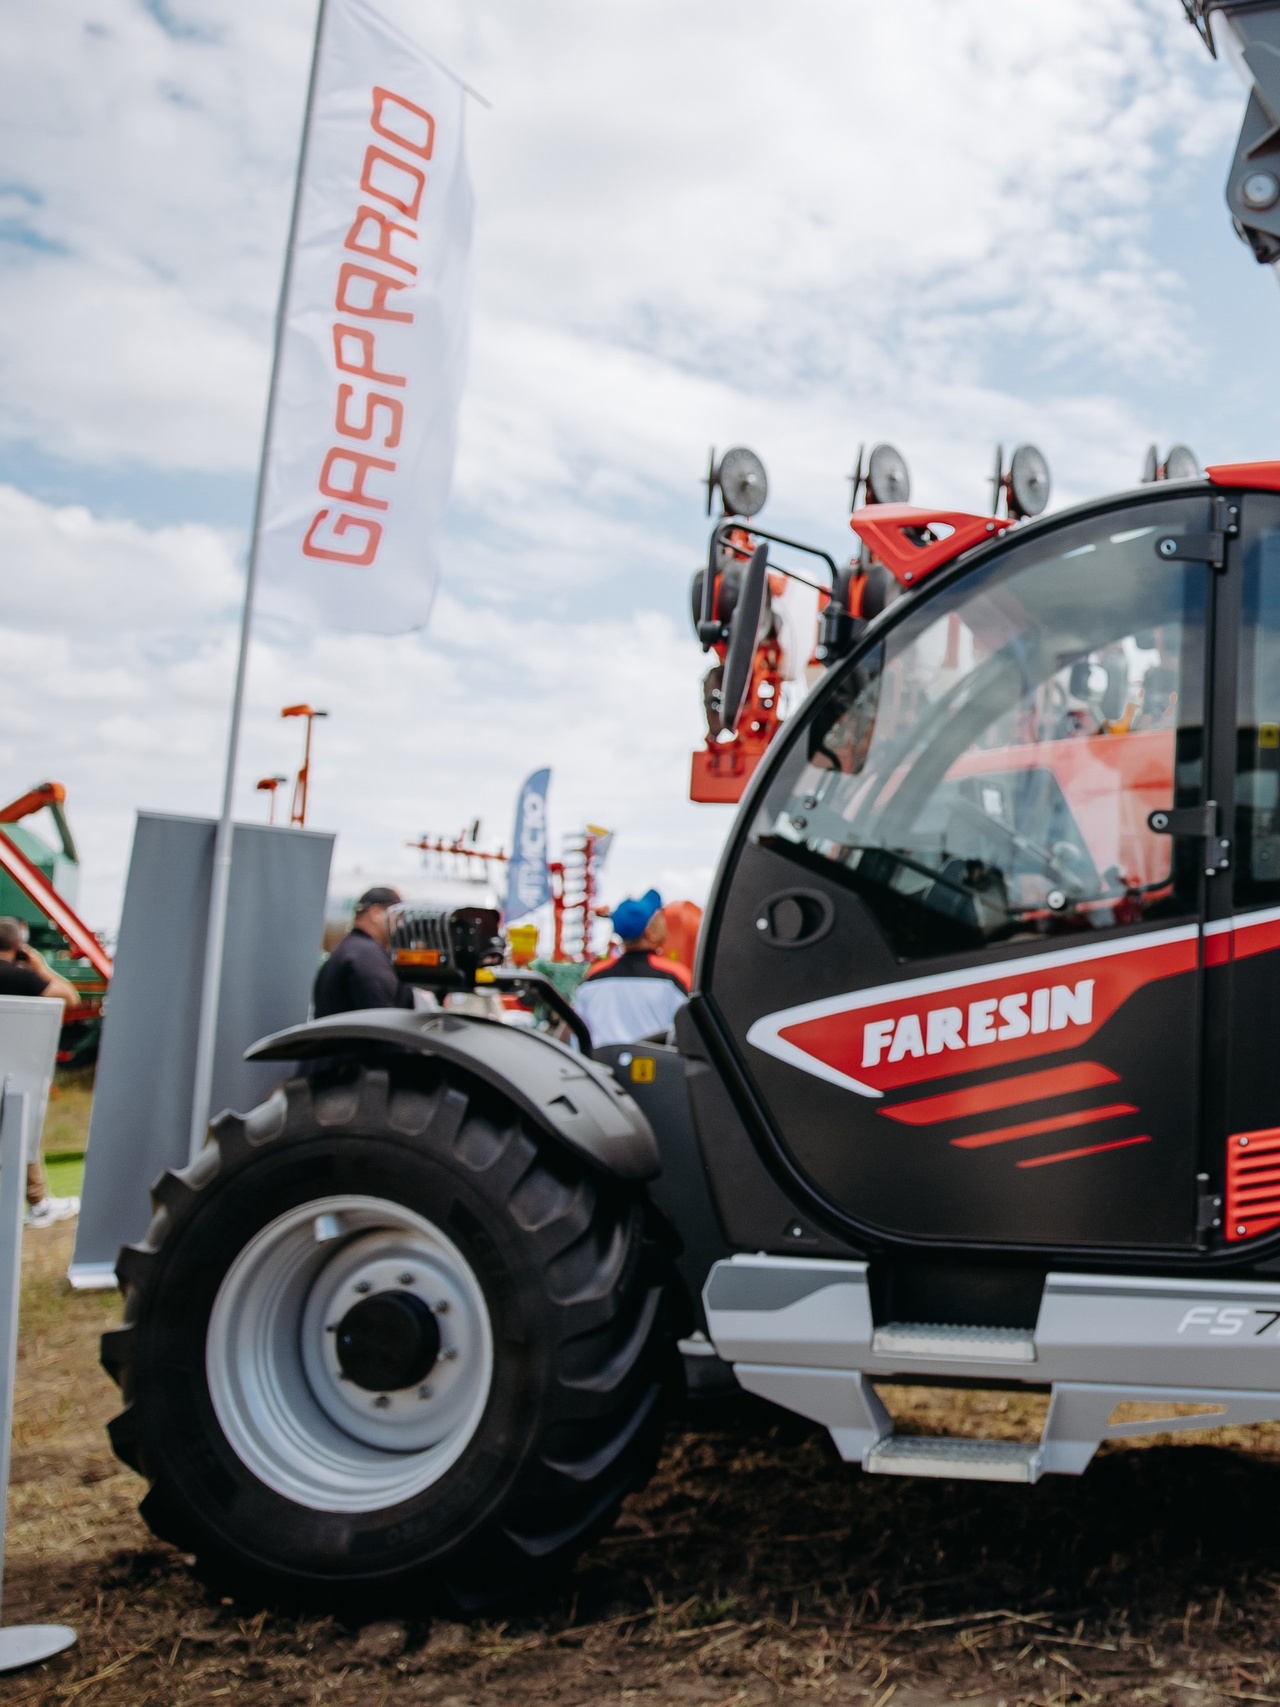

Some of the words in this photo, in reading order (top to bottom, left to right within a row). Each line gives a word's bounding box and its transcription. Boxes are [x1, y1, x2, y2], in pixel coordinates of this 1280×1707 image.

[302, 85, 435, 566] GASPARDO
[861, 979, 1095, 1068] FARESIN
[1177, 1306, 1250, 1336] FS
